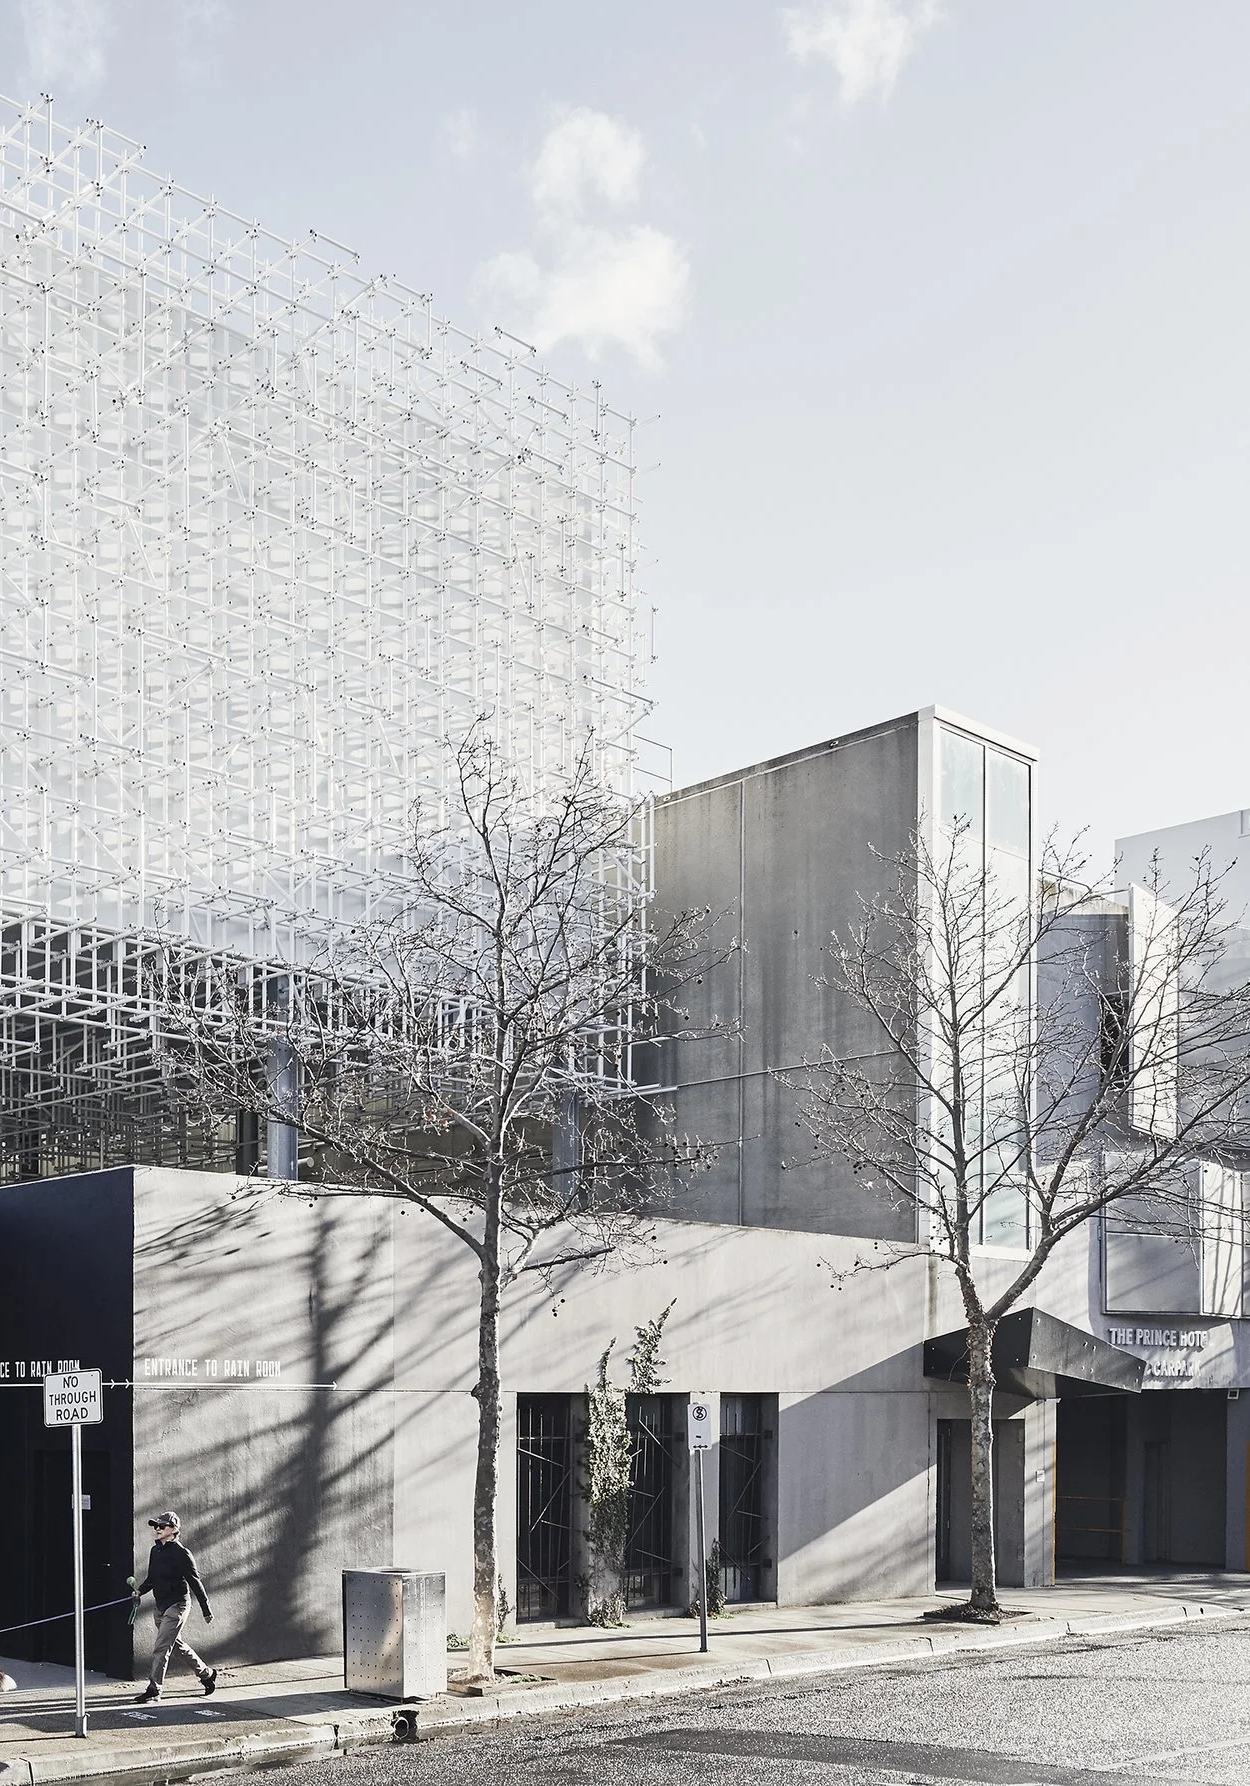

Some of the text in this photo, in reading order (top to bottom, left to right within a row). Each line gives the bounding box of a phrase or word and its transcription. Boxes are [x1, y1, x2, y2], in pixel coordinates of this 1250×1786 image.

[1110, 1328, 1133, 1345] THE
[1135, 1329, 1177, 1346] PRINCE
[14, 1361, 26, 1378] TO
[30, 1360, 52, 1378] RAIN
[144, 1358, 282, 1378] ENTRANCE TO RAIN ROOM
[62, 1375, 79, 1389] NO
[49, 1391, 96, 1406] THROUGH
[56, 1407, 88, 1421] ROAD
